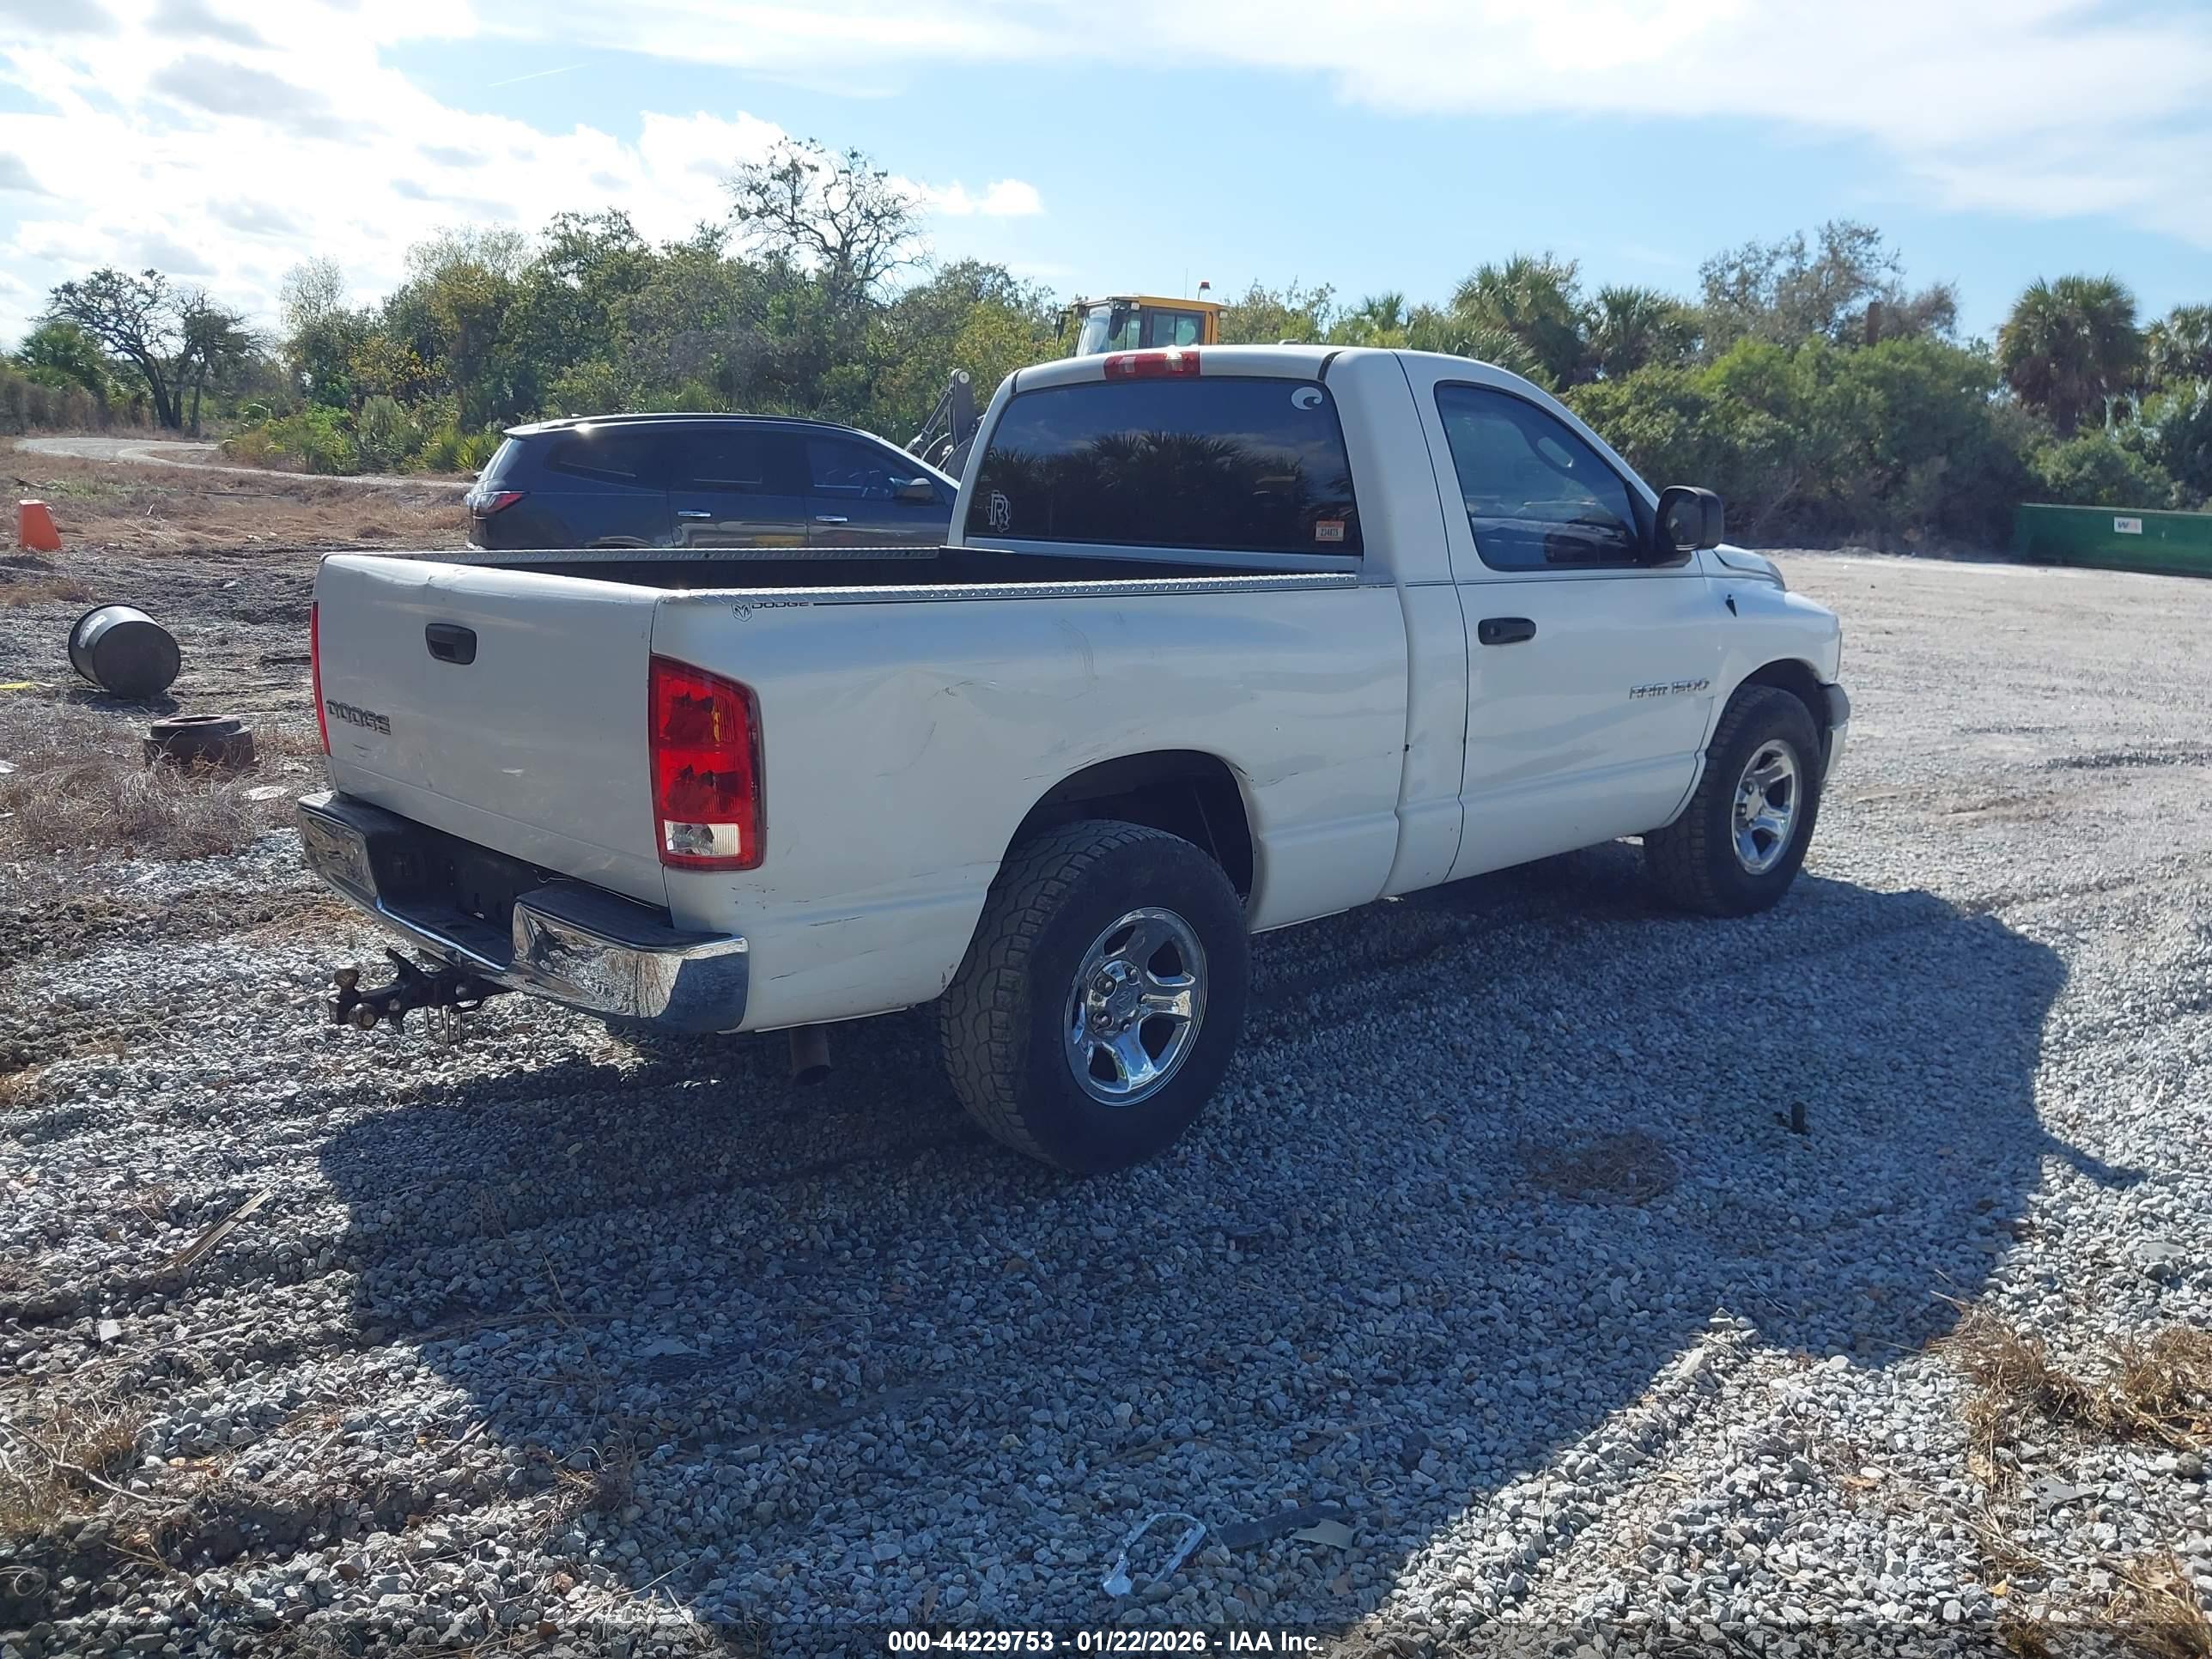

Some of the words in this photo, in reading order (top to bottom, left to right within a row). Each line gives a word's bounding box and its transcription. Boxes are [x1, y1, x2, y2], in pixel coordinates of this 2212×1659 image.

[751, 601, 810, 610] DODGE
[1671, 678, 1711, 695] 1500
[325, 698, 392, 736] DODGE
